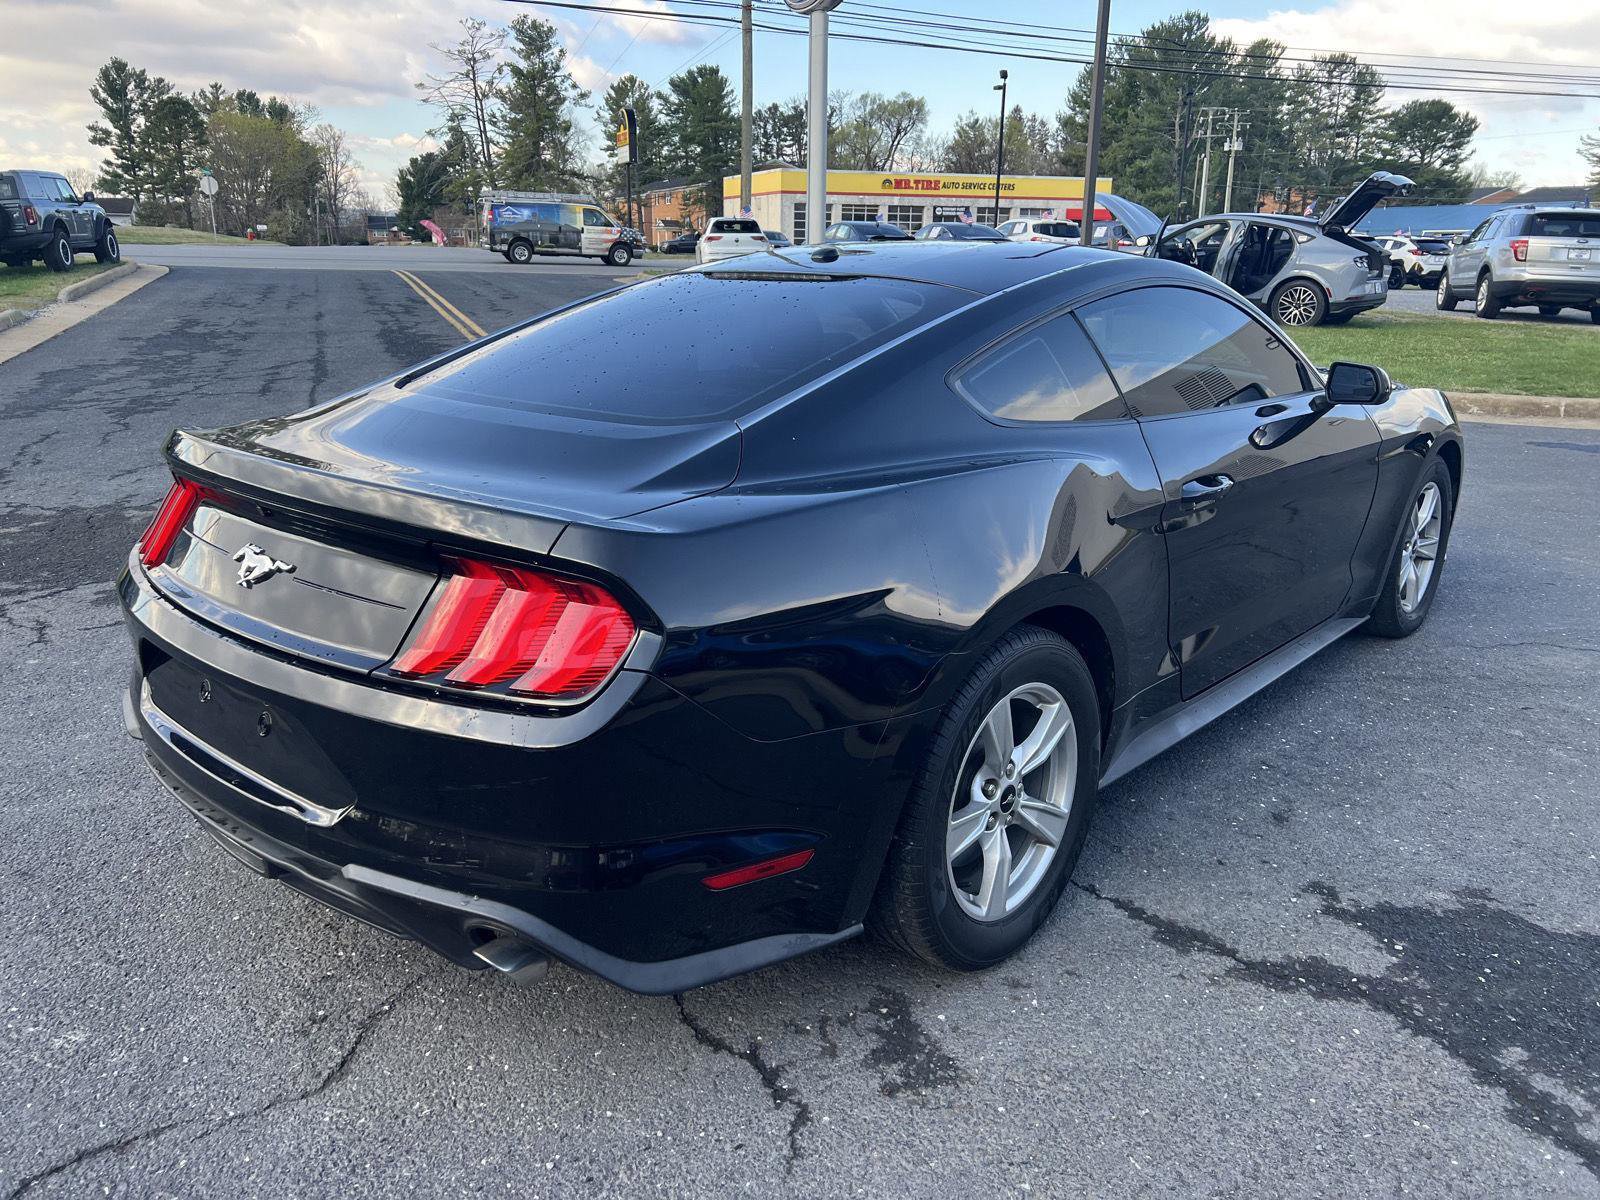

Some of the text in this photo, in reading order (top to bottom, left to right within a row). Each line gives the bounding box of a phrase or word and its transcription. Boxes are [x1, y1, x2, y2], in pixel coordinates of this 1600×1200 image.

[913, 180, 940, 190] TIRE
[942, 182, 959, 190] AUTO
[961, 182, 986, 191] SERVICE
[988, 183, 1015, 191] CETERS
